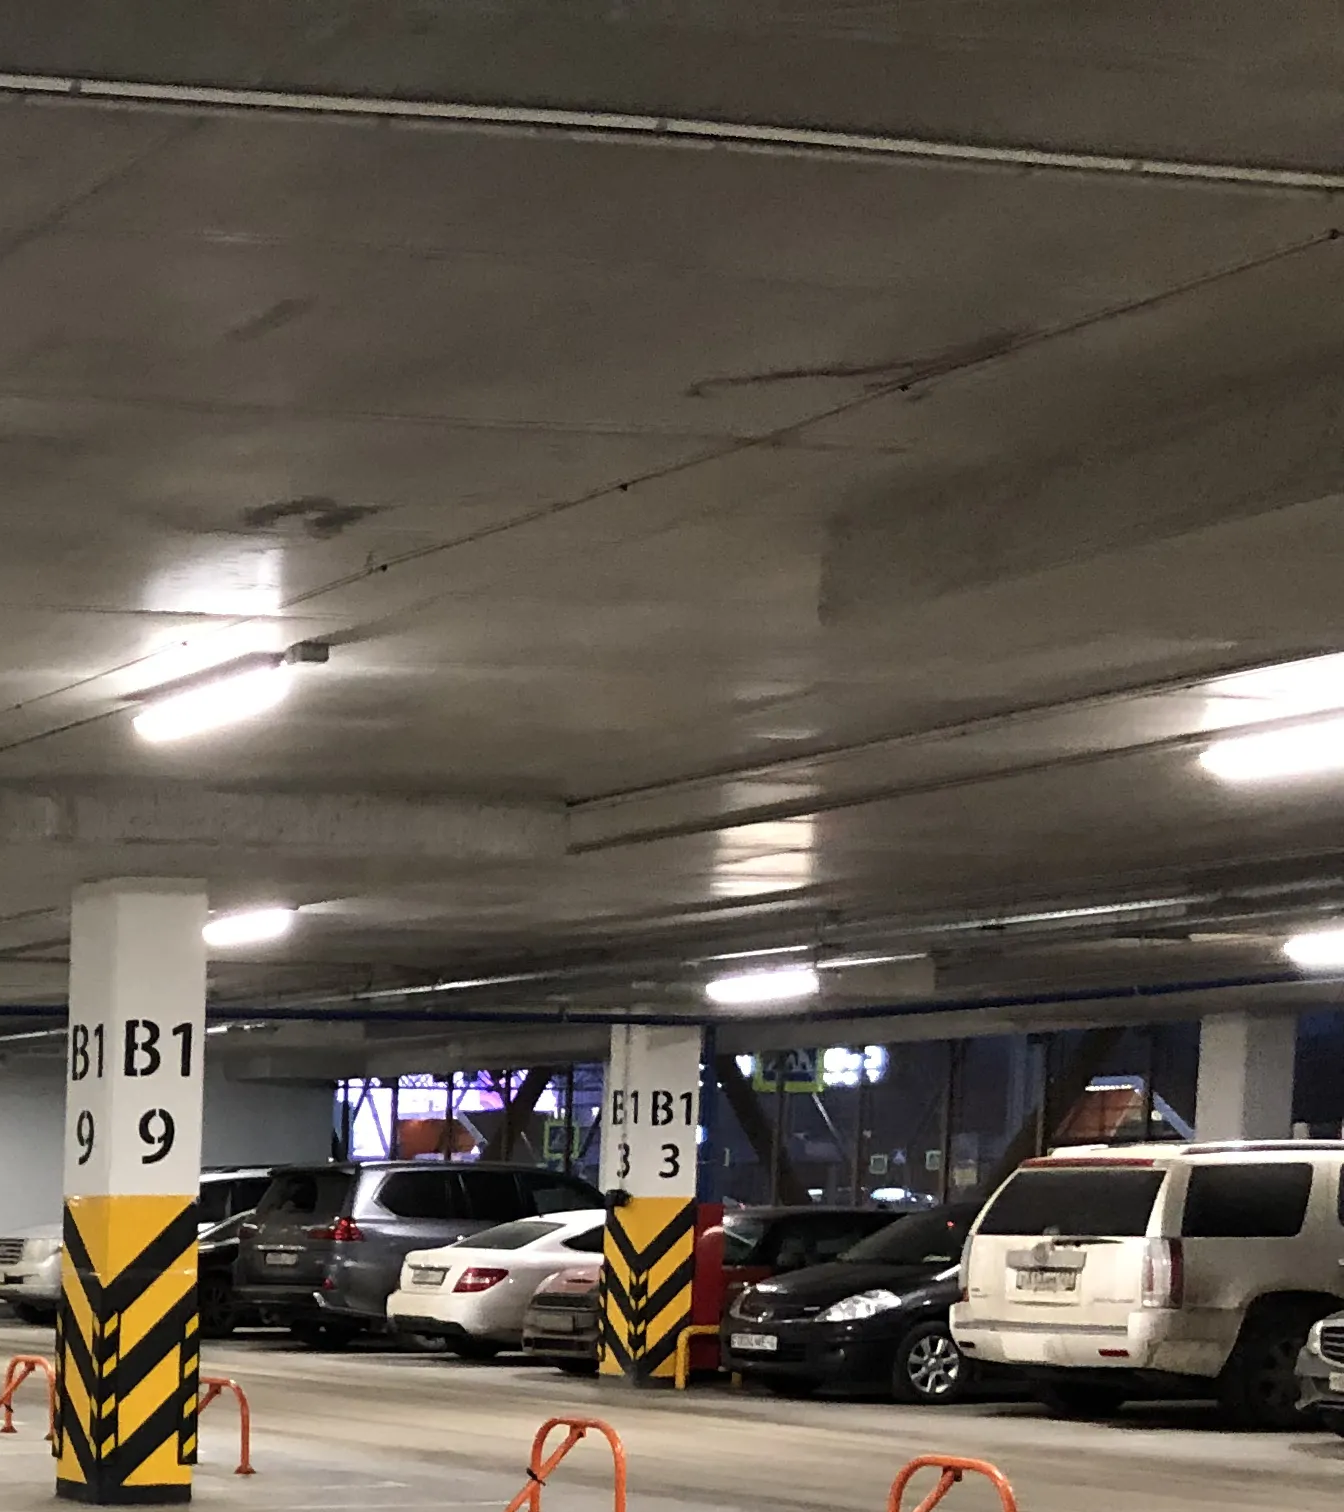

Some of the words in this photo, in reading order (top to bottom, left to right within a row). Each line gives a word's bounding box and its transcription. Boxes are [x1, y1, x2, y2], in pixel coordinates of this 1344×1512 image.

[71, 1024, 104, 1080] B1
[124, 1019, 193, 1077] B1
[651, 1090, 692, 1126] B1
[77, 1110, 95, 1165] 9
[138, 1108, 175, 1164] 9
[617, 1143, 630, 1179] 3
[659, 1143, 680, 1178] 3
